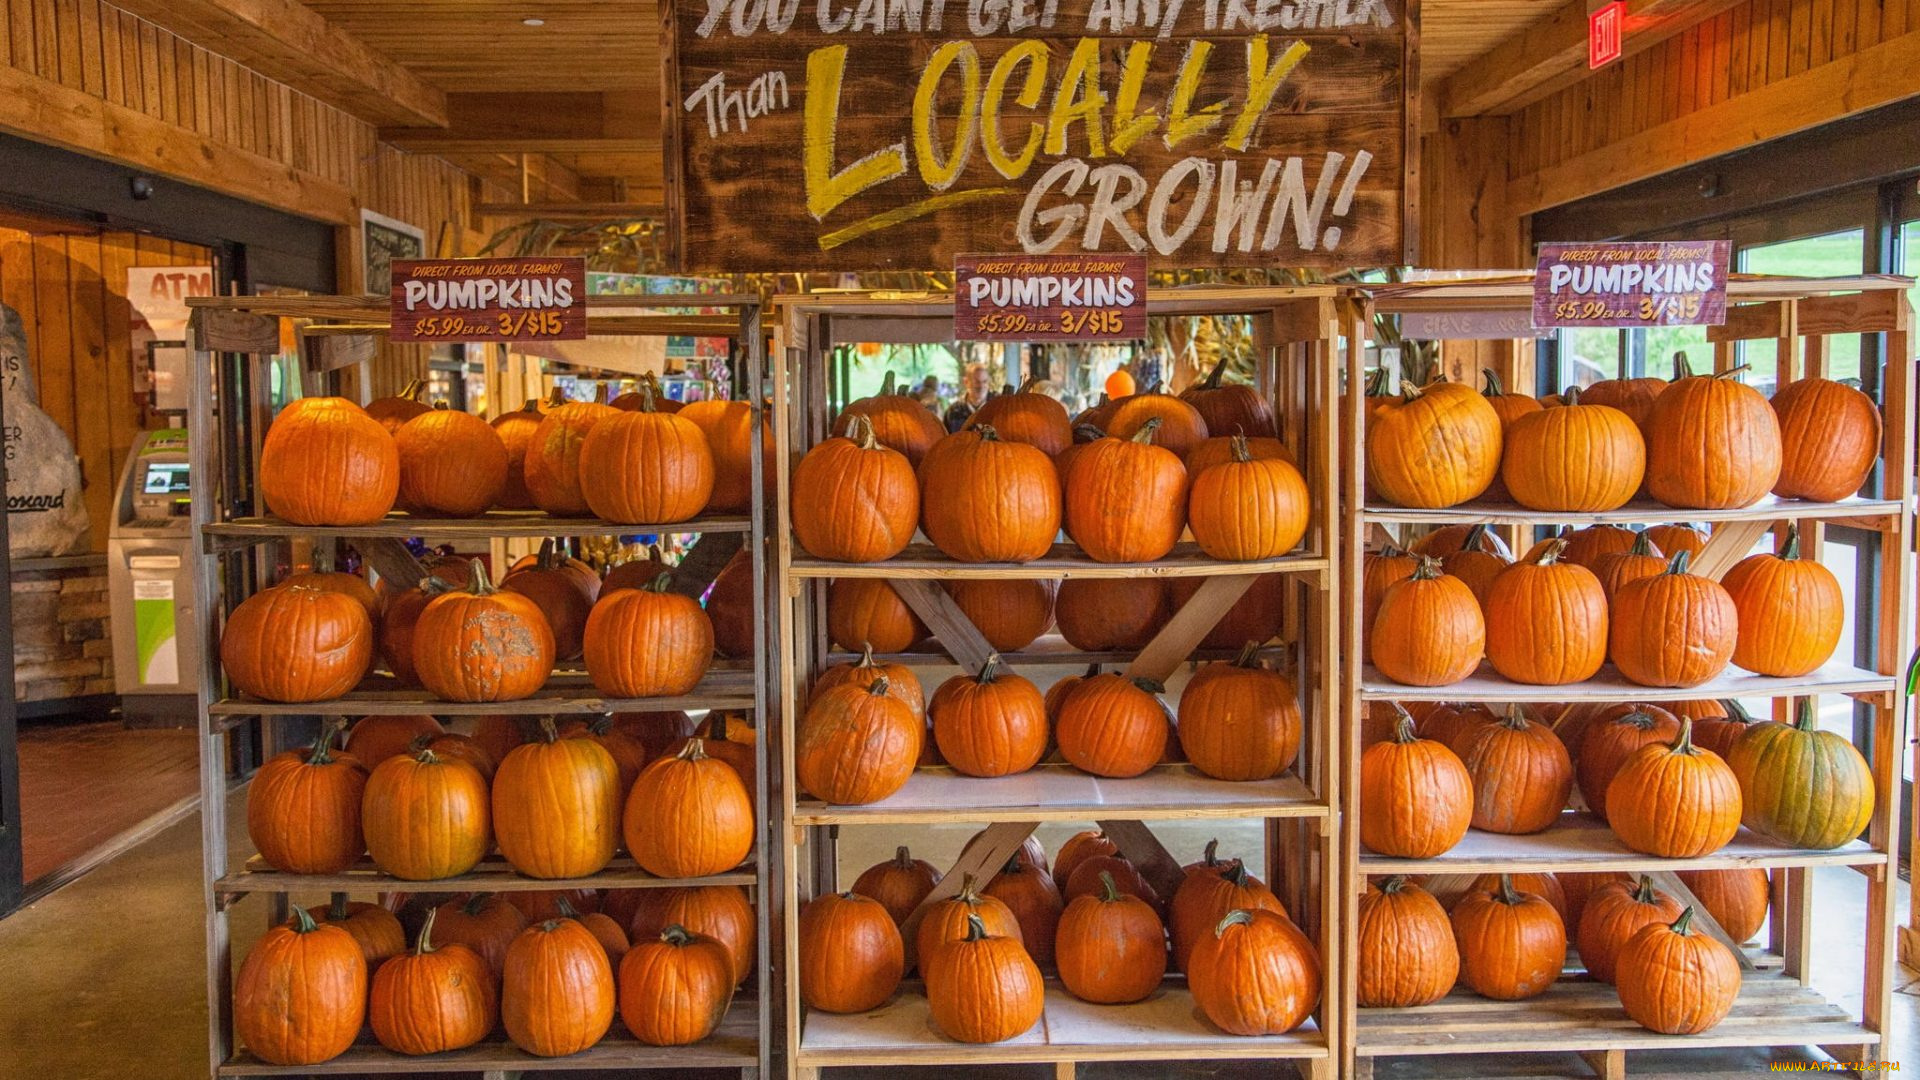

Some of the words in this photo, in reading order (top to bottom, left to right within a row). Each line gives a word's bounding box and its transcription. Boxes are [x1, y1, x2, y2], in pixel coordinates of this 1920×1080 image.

[695, 0, 799, 38] YOU
[968, 0, 1058, 36] GET
[1595, 8, 1616, 61] EXIT
[684, 71, 789, 138] Than
[803, 33, 1311, 223] LOCALLY
[1016, 149, 1373, 255] GROWN!
[976, 263, 1013, 274] DIRECT
[1016, 263, 1048, 273] FROM
[1050, 263, 1080, 273] LOCAL
[1084, 262, 1125, 273] FARMS!
[1560, 250, 1597, 262] DIRECT
[1599, 250, 1632, 261] FROM
[1634, 249, 1664, 261] LOCAL
[1667, 248, 1707, 260] FARMS!
[412, 266, 451, 277] DIRECT
[452, 265, 485, 276] FROM
[486, 264, 518, 276] LOCAL
[520, 263, 562, 275] FARMS!
[1550, 262, 1714, 295] PUMPKINS
[150, 273, 211, 300] ATM
[403, 277, 574, 310] PUMPKINS
[967, 276, 1135, 307] PUMPKINS
[1060, 310, 1123, 335] 3/$15
[1638, 296, 1700, 320] 3/$15
[499, 310, 562, 336] 3/$15
